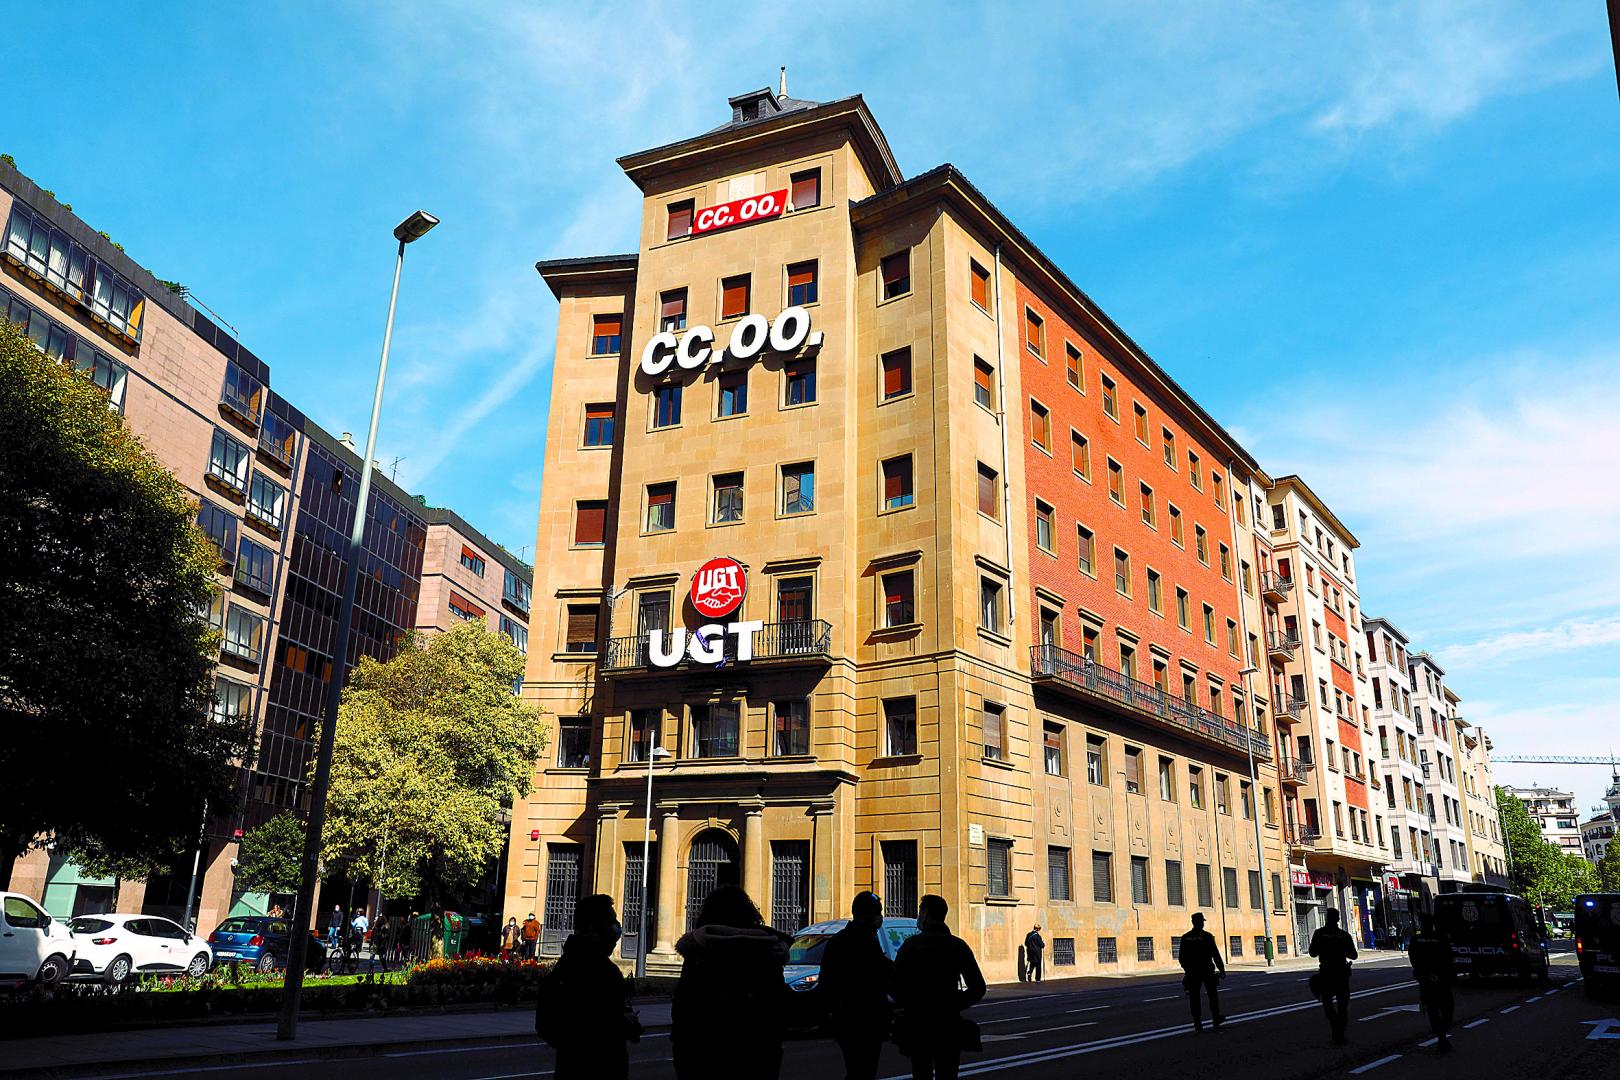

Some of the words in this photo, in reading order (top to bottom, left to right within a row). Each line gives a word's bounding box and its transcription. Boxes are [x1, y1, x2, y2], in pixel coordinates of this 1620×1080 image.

[697, 207, 734, 230] CC.
[740, 195, 780, 219] OO.
[698, 565, 740, 594] UGT
[649, 621, 764, 667] UGT
